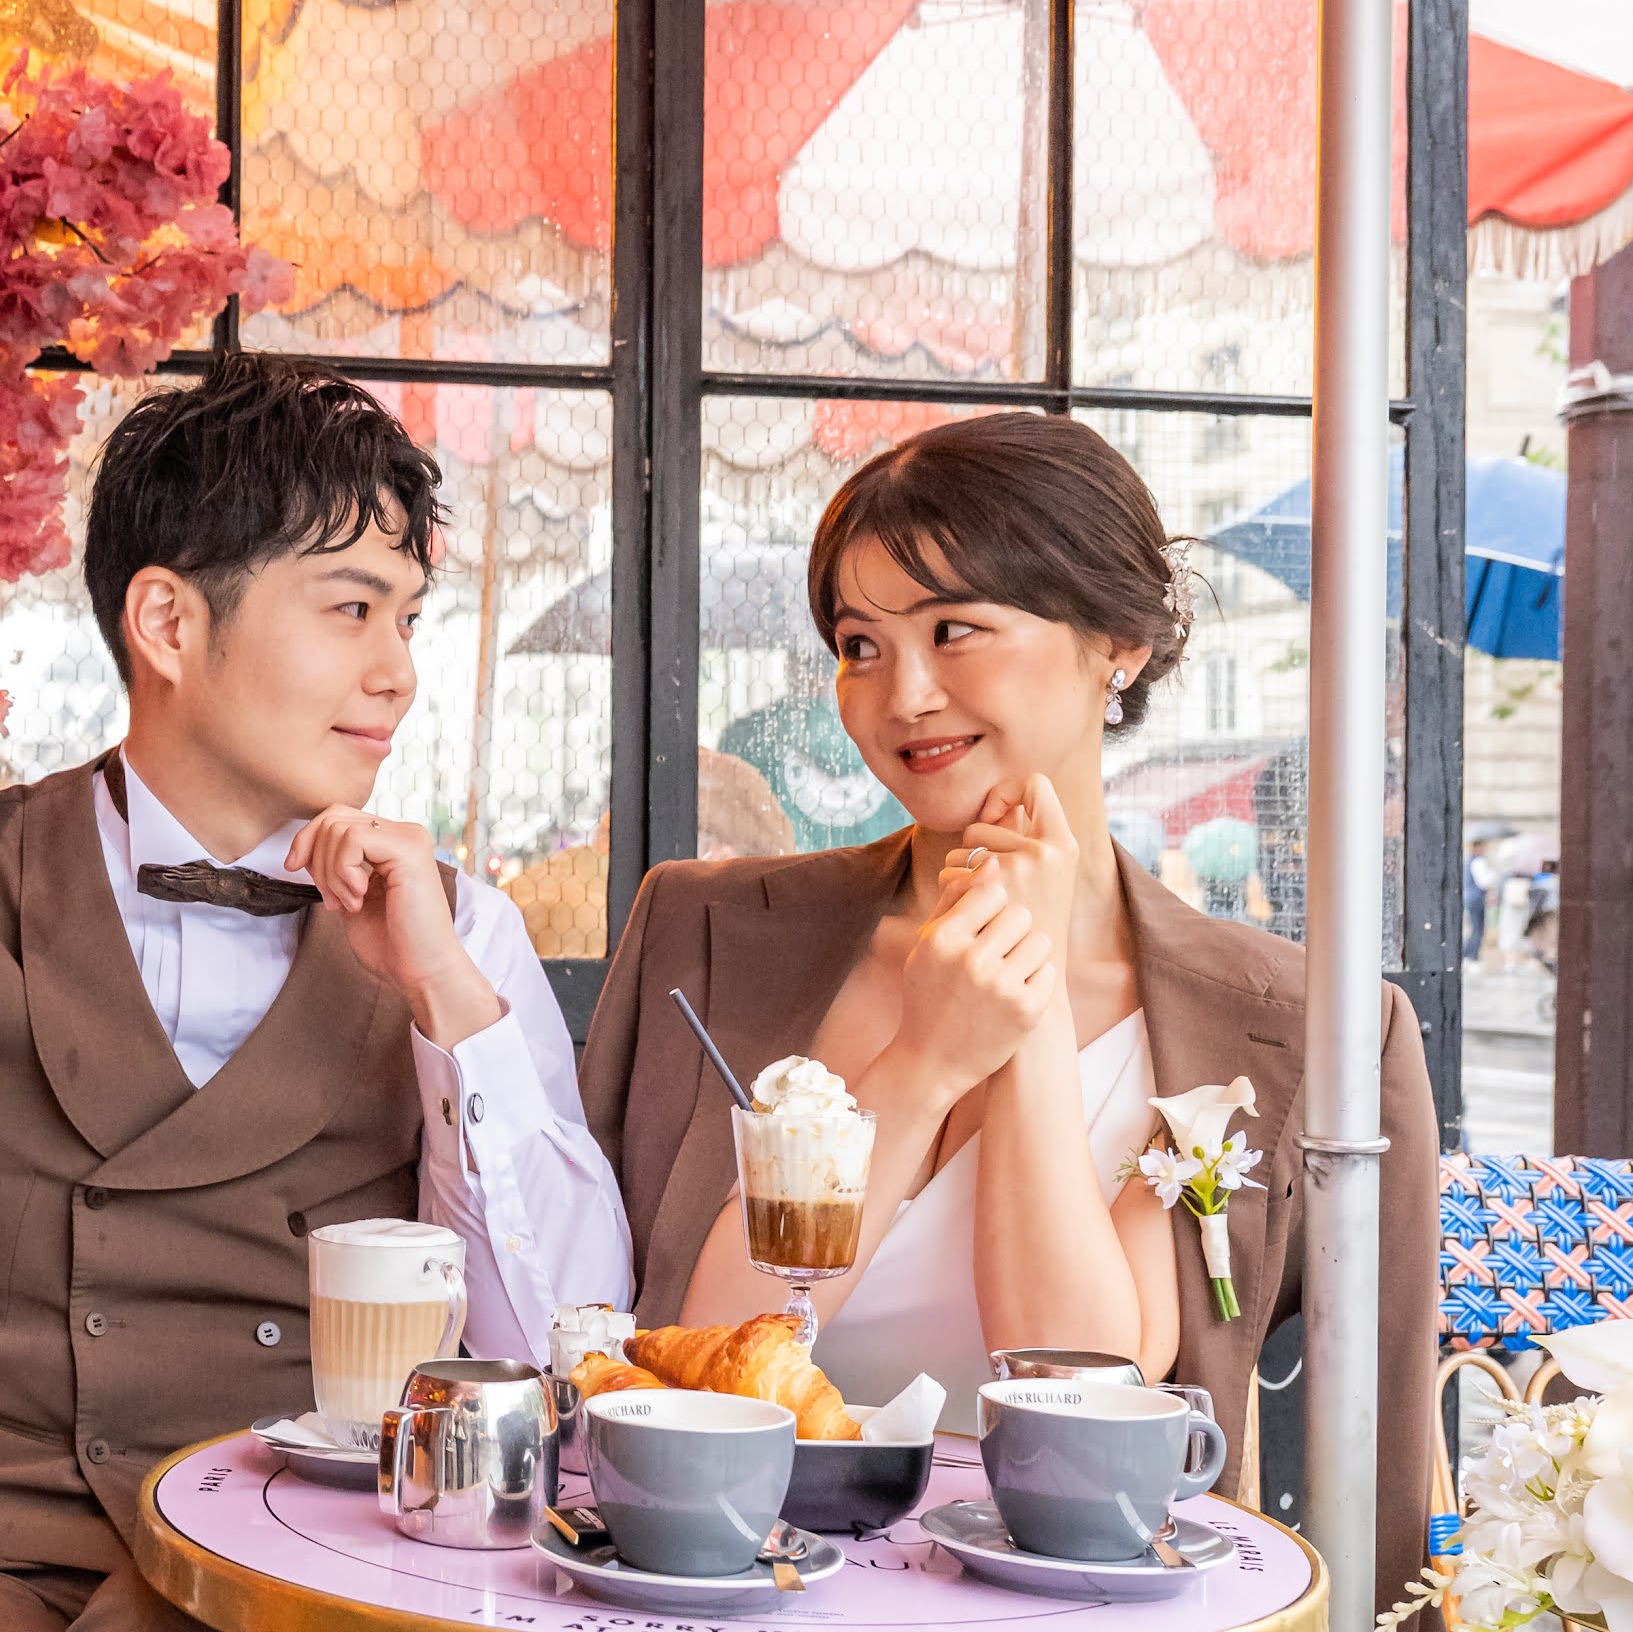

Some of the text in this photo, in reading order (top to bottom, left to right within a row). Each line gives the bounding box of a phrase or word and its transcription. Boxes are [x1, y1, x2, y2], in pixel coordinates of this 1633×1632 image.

[1025, 1392, 1082, 1405] RICHARD
[607, 1404, 652, 1418] RICHARD
[198, 1467, 233, 1492] PARIS
[1208, 1520, 1264, 1572] LE MARAIS
[470, 1608, 536, 1624] I'M
